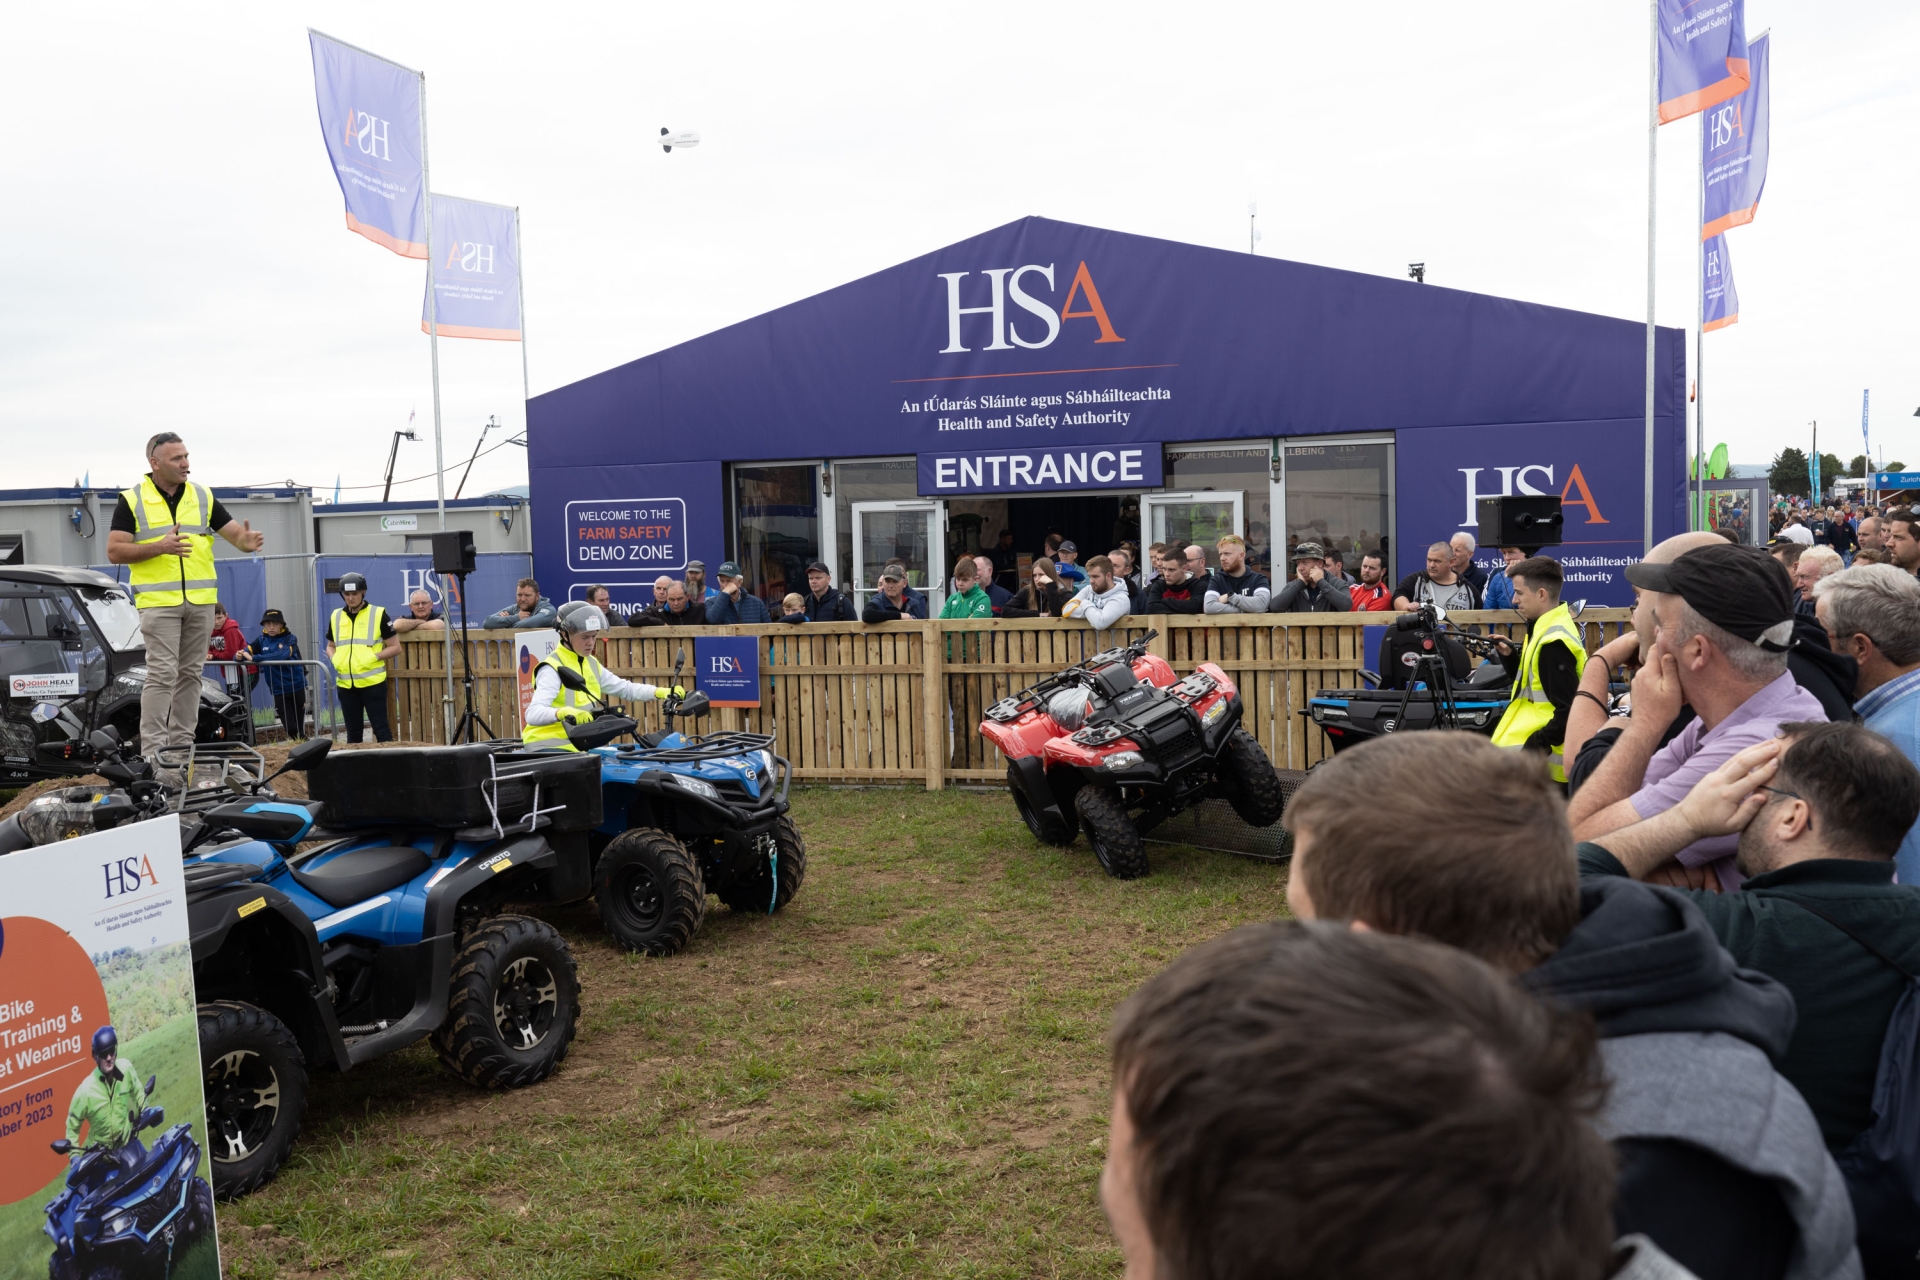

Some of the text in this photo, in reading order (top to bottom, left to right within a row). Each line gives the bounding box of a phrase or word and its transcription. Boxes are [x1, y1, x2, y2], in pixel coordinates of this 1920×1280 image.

[1710, 101, 1745, 152] HSA
[937, 260, 1126, 354] HSA
[900, 387, 1171, 413] An tÚdarás Sláinte agus Sábháilteachta
[938, 410, 1131, 431] Health and Safety Authority
[1166, 452, 1205, 460] FARMER
[1207, 450, 1244, 459] HEALTH
[1246, 449, 1266, 457] AND
[935, 450, 1143, 488] ENTRANCE
[579, 509, 671, 521] WELCOME TO THE
[579, 525, 672, 540] FARM SAFETY
[580, 545, 673, 560] DEMO ZONE
[400, 568, 462, 606] HSA
[1458, 593, 1467, 601] 83
[609, 603, 642, 616] RING
[711, 657, 743, 672] HSA
[479, 851, 511, 870] CFMOTO
[101, 853, 159, 899] HSA
[107, 922, 120, 932] Health
[130, 916, 142, 924] Safety
[144, 910, 162, 920] Authority
[0, 1000, 34, 1024] Bike
[0, 1005, 82, 1049] Training &
[0, 1034, 82, 1078] et Wearing
[0, 1087, 53, 1118] tory from
[0, 1104, 54, 1138] ber 2023
